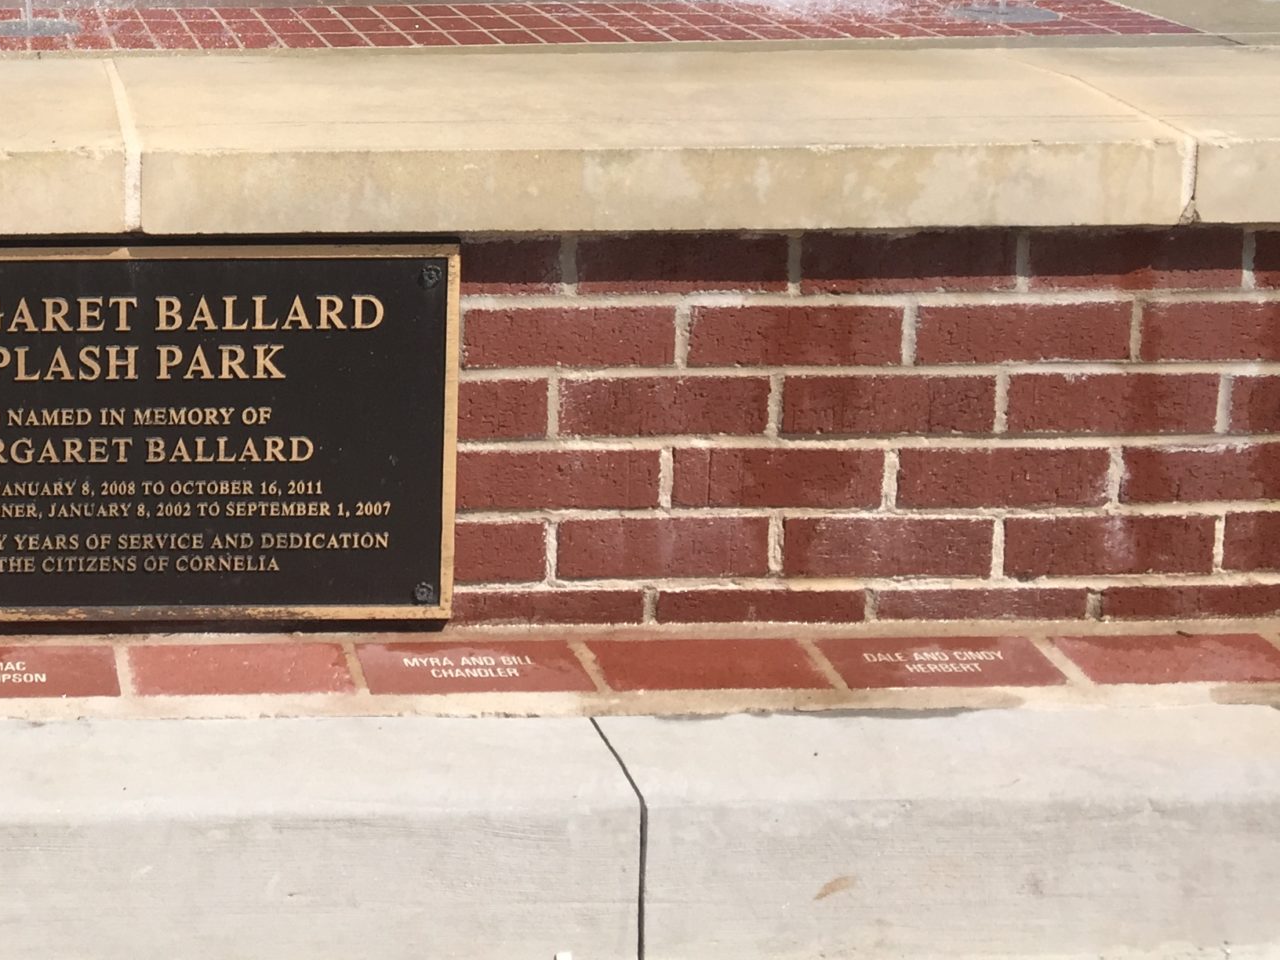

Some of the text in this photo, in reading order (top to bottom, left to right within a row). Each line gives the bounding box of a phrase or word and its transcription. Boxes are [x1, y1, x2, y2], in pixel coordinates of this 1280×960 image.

[155, 294, 385, 331] BALLARD
[156, 343, 286, 380] PARK
[7, 408, 92, 426] NAMED
[100, 407, 126, 426] IN
[133, 407, 235, 426] MEMORY
[241, 406, 272, 425] OF
[146, 436, 314, 463] BALLARD
[81, 481, 95, 496] 8,
[101, 480, 136, 496] 2008
[141, 480, 165, 495] TO
[170, 479, 254, 495] OCTOBER
[261, 480, 282, 497] 16,
[287, 479, 323, 495] 2011
[48, 502, 131, 518] JANUARY
[137, 503, 151, 518] 8,
[156, 501, 191, 517] 2002
[196, 501, 220, 517] TO
[225, 501, 331, 517] SEPTEMBER
[337, 502, 350, 518] 1,
[355, 501, 391, 516] 2007
[14, 534, 79, 550] YEARS
[85, 533, 112, 550] OF
[118, 533, 204, 550] SERVICE
[210, 532, 254, 549] AND
[261, 531, 389, 549] DEDICATION
[42, 555, 137, 572] CITIZENS
[144, 555, 169, 571] OF
[176, 555, 280, 572] CORNELIA
[403, 655, 535, 667] MYRA AND BILL
[863, 650, 1004, 662] DALE AND CINDY
[431, 668, 519, 678] CHANDLER
[905, 663, 982, 673] HERBERT
